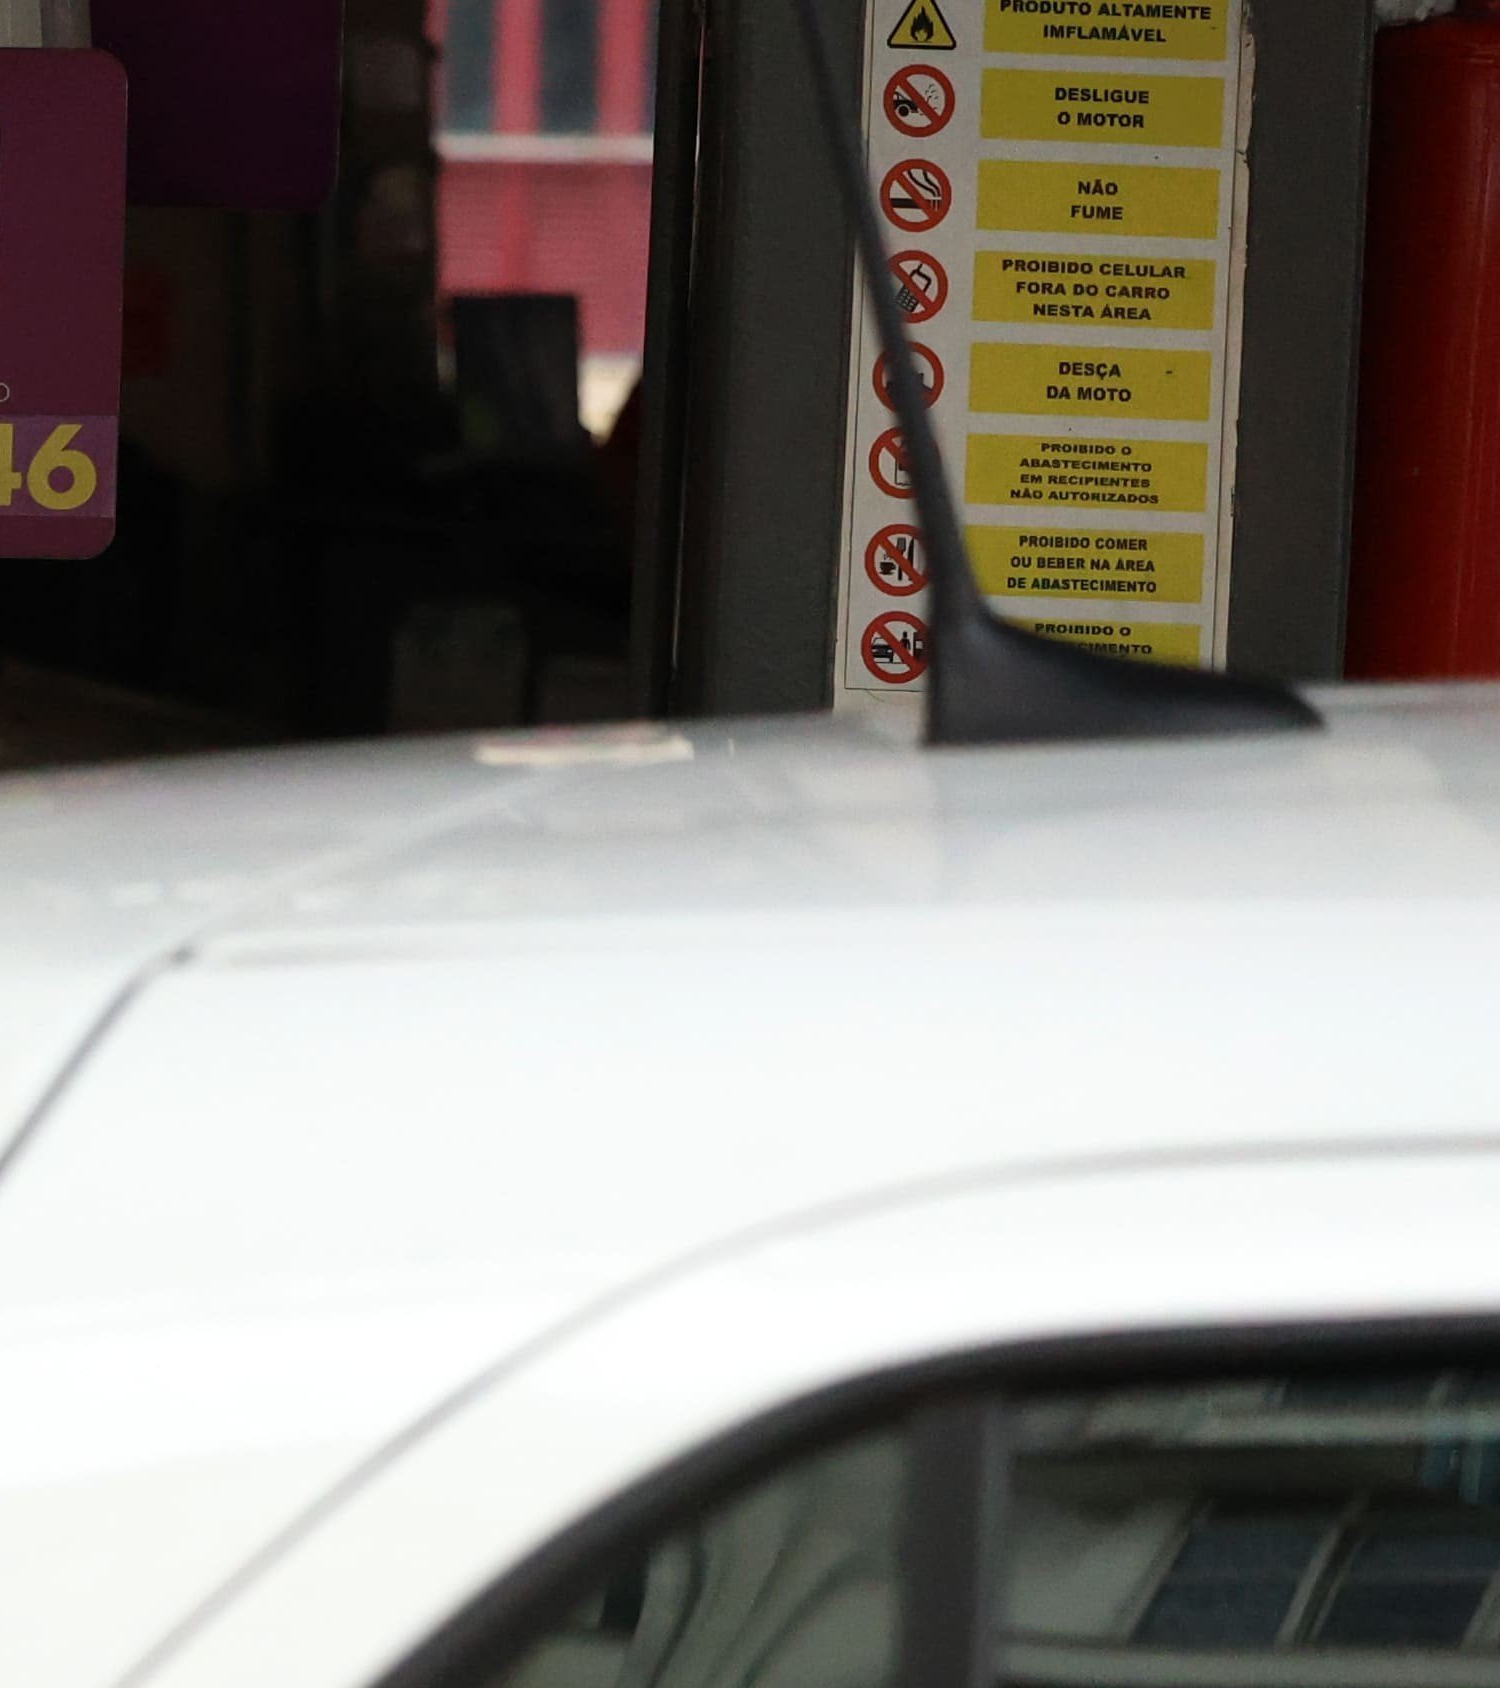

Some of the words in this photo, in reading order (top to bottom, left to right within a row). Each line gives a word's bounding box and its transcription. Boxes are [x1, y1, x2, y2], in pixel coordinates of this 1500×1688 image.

[1044, 25, 1166, 42] IMFLAMÁVEL
[1055, 88, 1149, 104] DESLIGUE
[1058, 112, 1070, 124] O
[1077, 113, 1144, 128] MOTOR
[1078, 179, 1118, 195] NÃO
[1071, 205, 1123, 220] FUME
[1003, 259, 1093, 274] PROIBIDO
[1099, 264, 1185, 278] CELULAR
[1017, 282, 1066, 295] FORA
[1073, 284, 1098, 296] DO
[1105, 285, 1169, 299] CARRO
[1034, 304, 1094, 318] NESTA
[1100, 304, 1151, 320] ÁREA
[1059, 362, 1121, 380] DESÇA
[1047, 386, 1070, 399] DA
[1077, 387, 1131, 402] MOTO
[1020, 536, 1090, 548] PROIBIDO
[1095, 538, 1147, 550] COMER
[1011, 556, 1031, 568] OU
[1037, 557, 1085, 569] BEBER
[1091, 559, 1110, 570] NA
[1115, 558, 1155, 572] ÁREA
[1008, 577, 1026, 588] DE
[1031, 578, 1156, 593] ABASTECIMENTO
